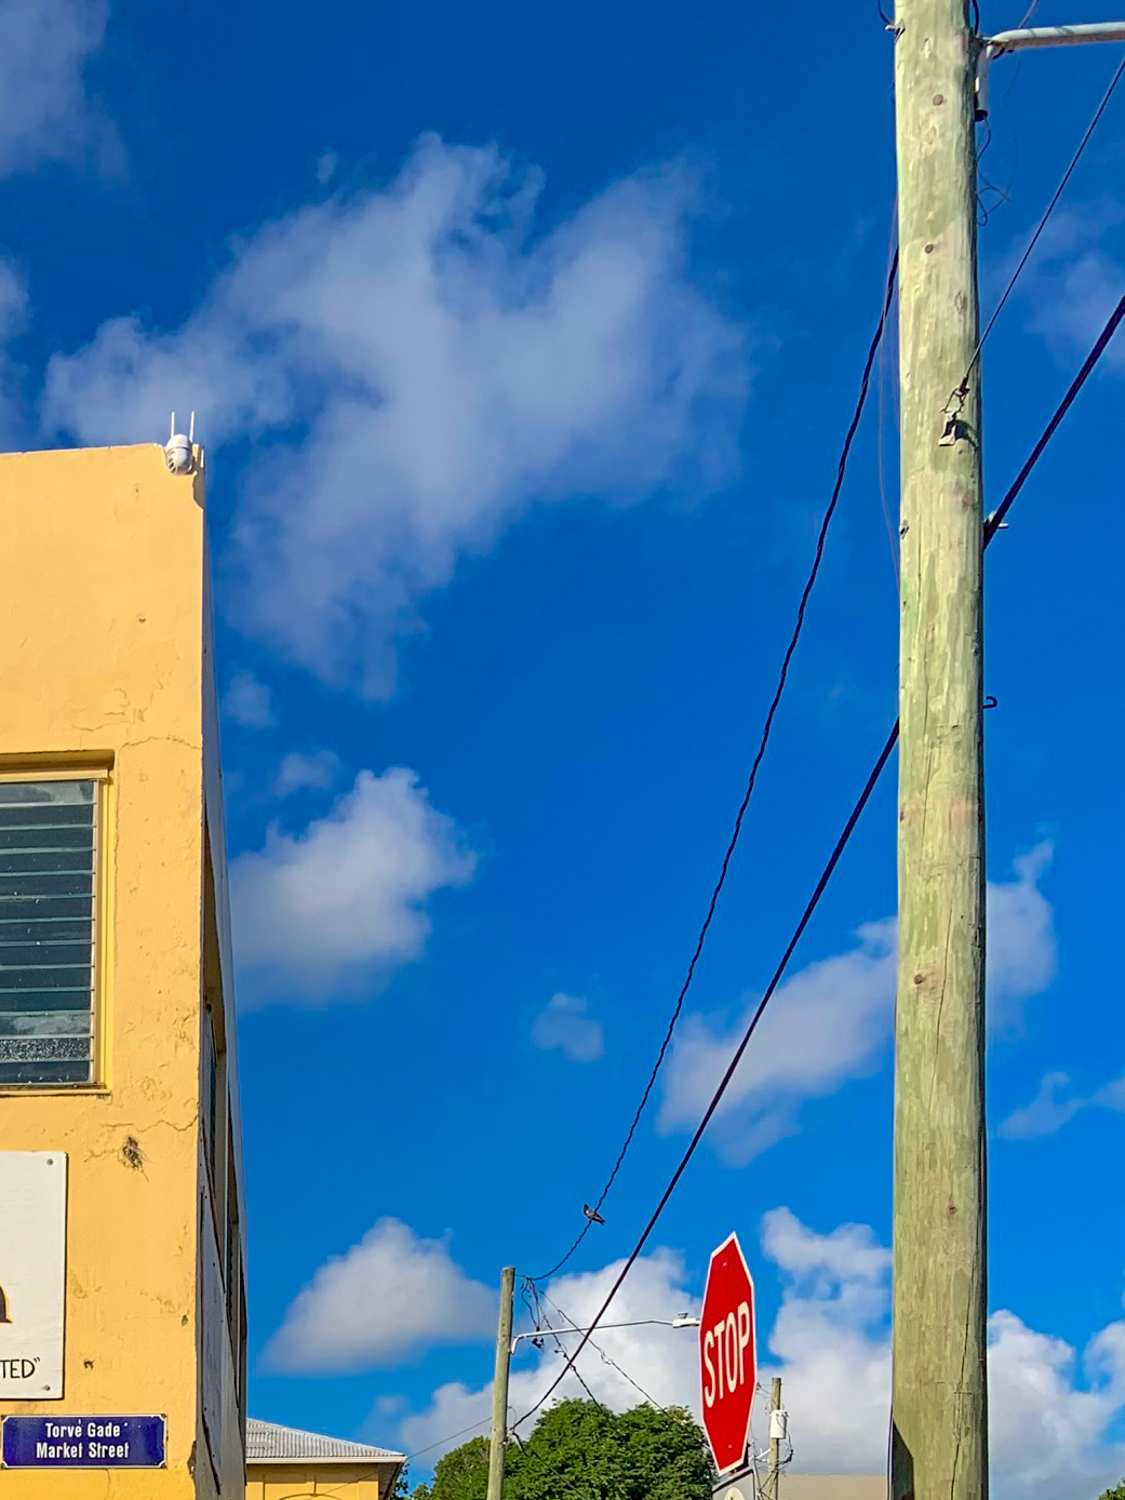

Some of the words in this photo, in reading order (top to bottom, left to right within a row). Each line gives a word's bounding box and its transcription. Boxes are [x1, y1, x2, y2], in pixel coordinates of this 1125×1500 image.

[704, 1300, 749, 1408] STOP
[87, 1422, 121, 1438] Gade
[36, 1442, 83, 1459] Market
[88, 1442, 129, 1459] Street
